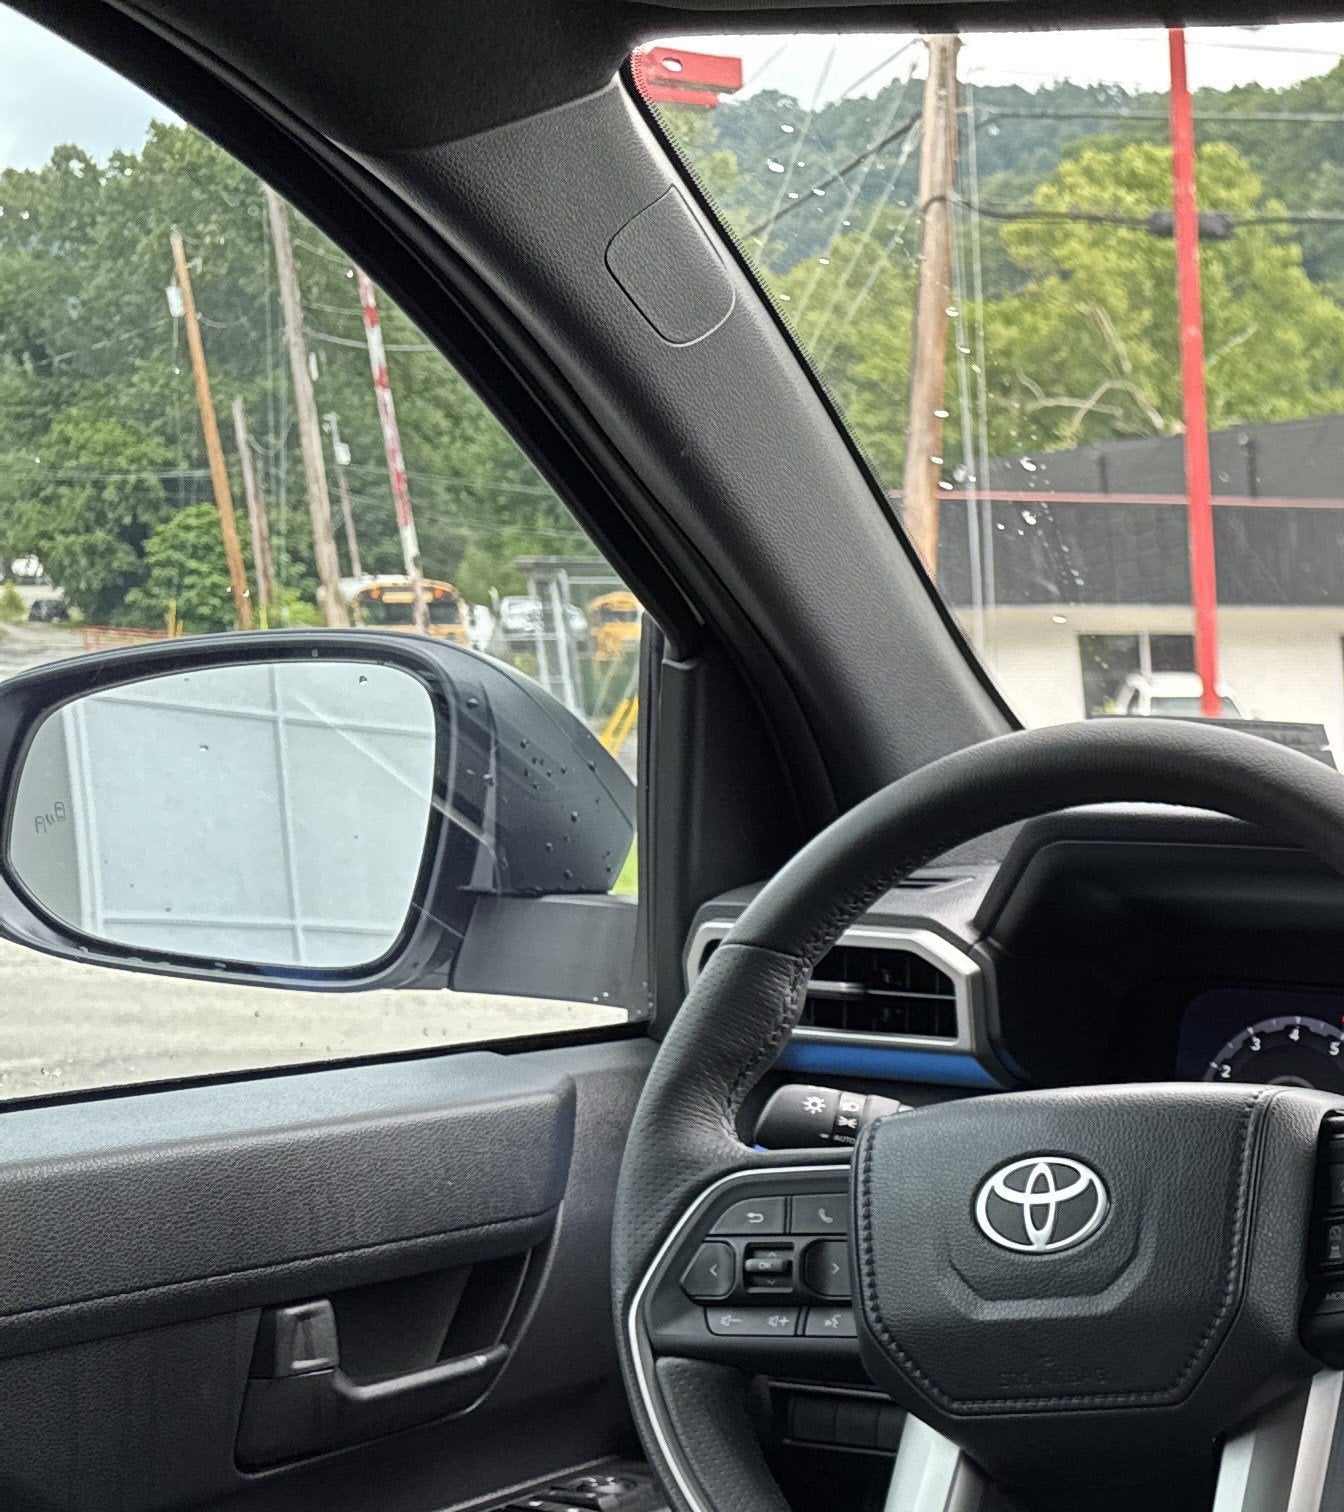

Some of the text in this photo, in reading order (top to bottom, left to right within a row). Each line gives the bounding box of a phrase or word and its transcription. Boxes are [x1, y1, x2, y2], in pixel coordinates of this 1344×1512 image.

[1289, 1028, 1299, 1041] 4
[1251, 1036, 1261, 1051] 3
[1329, 1041, 1340, 1056] 5
[1221, 1064, 1231, 1078] 2
